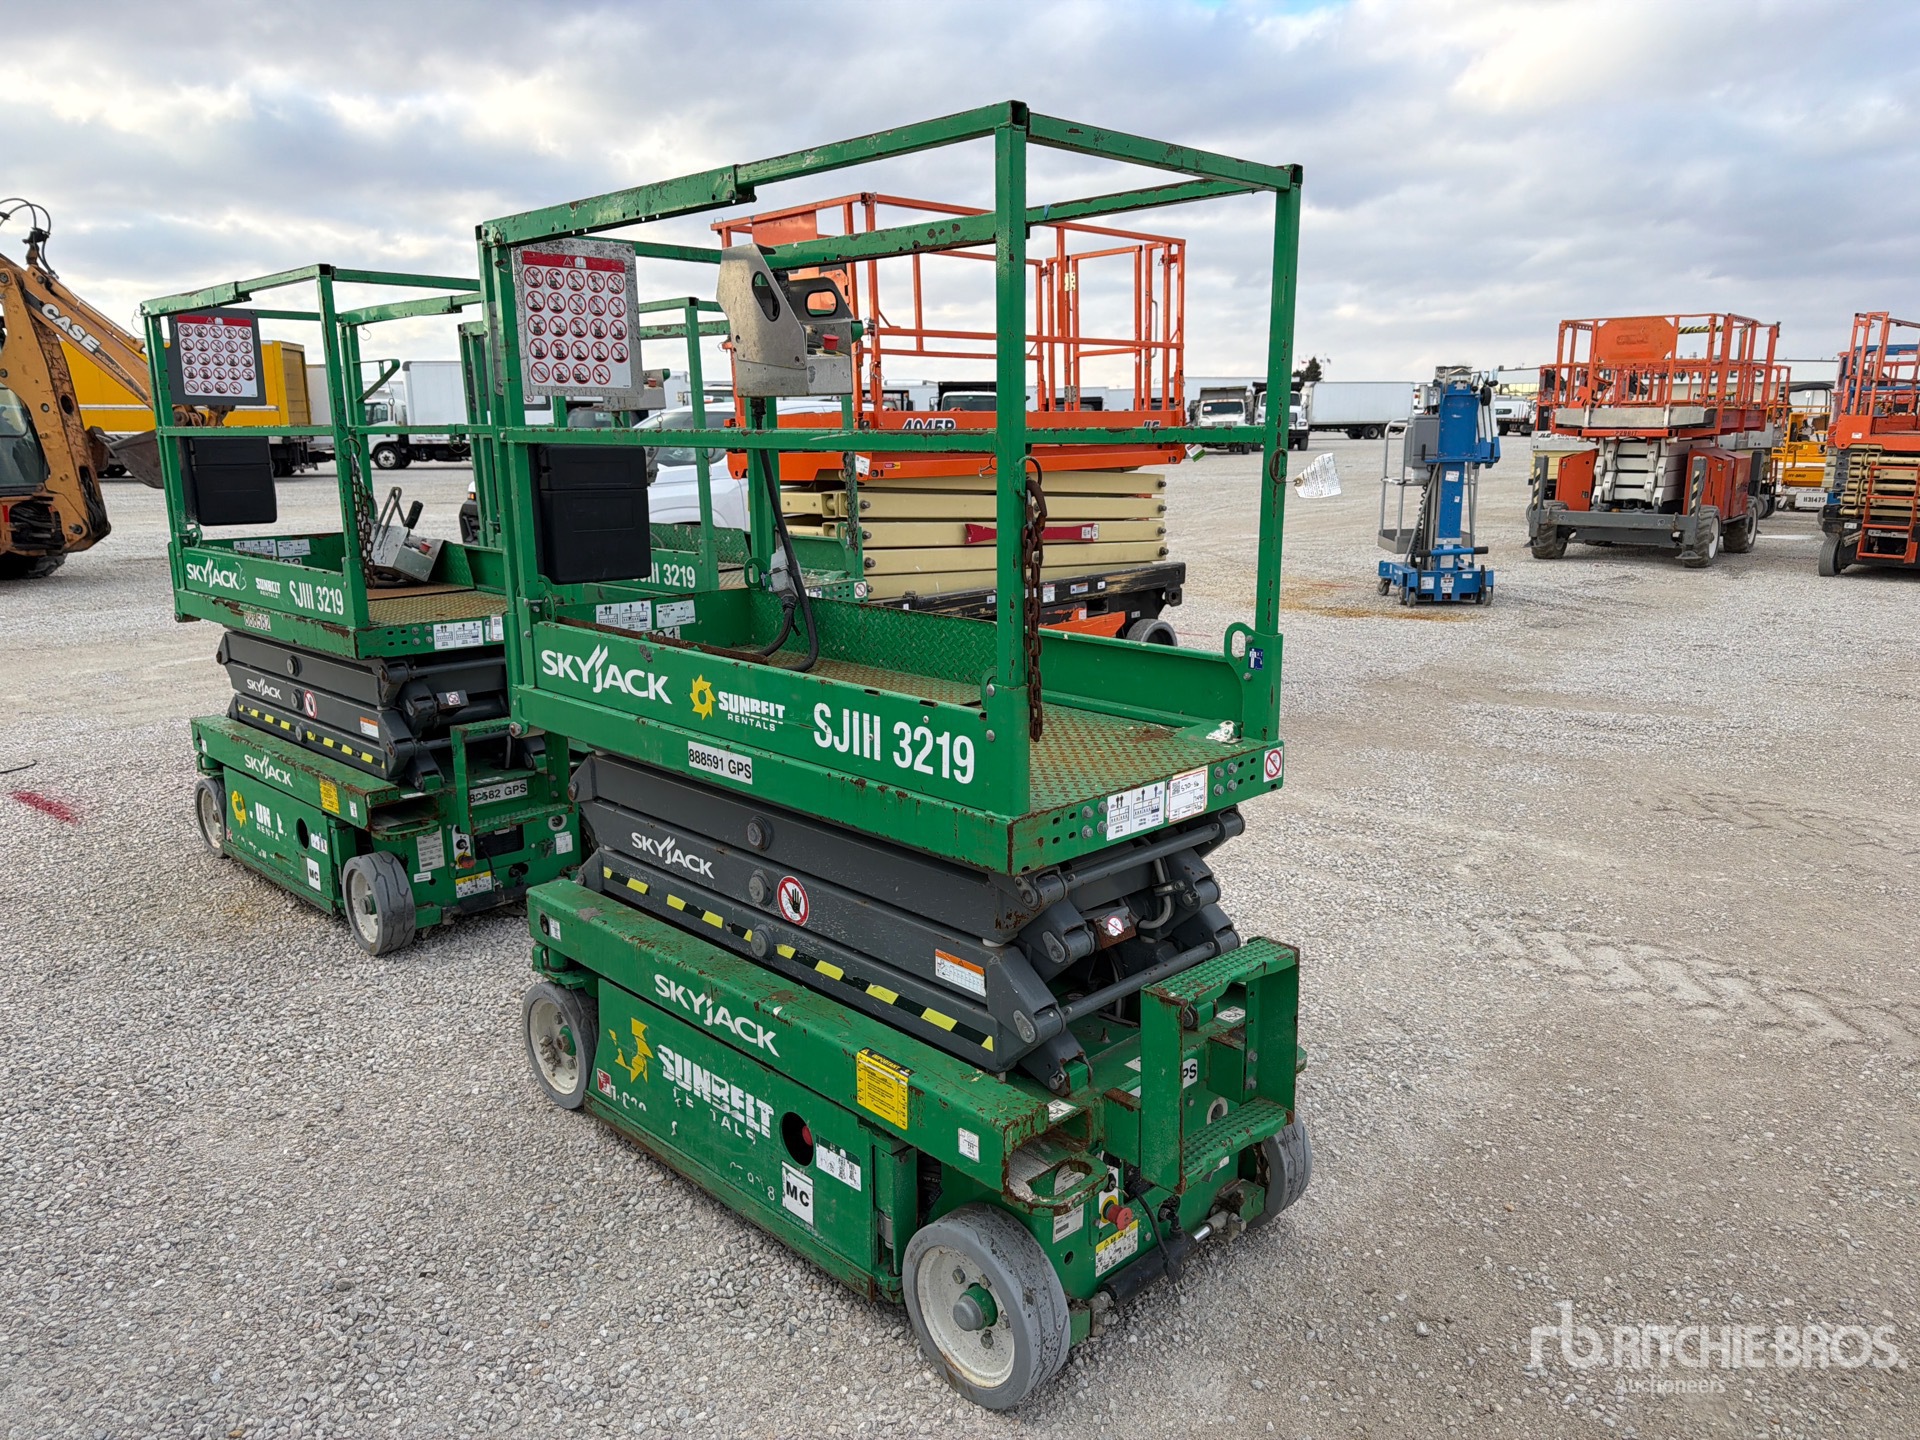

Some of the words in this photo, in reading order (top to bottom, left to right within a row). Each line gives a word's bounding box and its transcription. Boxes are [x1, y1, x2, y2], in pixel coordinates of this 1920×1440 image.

[41, 302, 101, 352] CASE
[186, 558, 240, 590] SKYJACK
[663, 563, 696, 589] 3219
[317, 586, 345, 615] 3219
[246, 678, 282, 700] SKYJACK
[541, 644, 672, 705] SKYJACK
[727, 713, 776, 731] RENTALS
[688, 748, 724, 772] 888591
[728, 758, 752, 780] GPS
[893, 721, 975, 784] 3219
[244, 755, 293, 787] SKYJACK
[504, 783, 527, 797] GPS
[631, 832, 715, 879] SKYJACK
[308, 868, 319, 881] MC
[654, 974, 780, 1058] SKYJACK
[786, 1181, 810, 1207] MC
